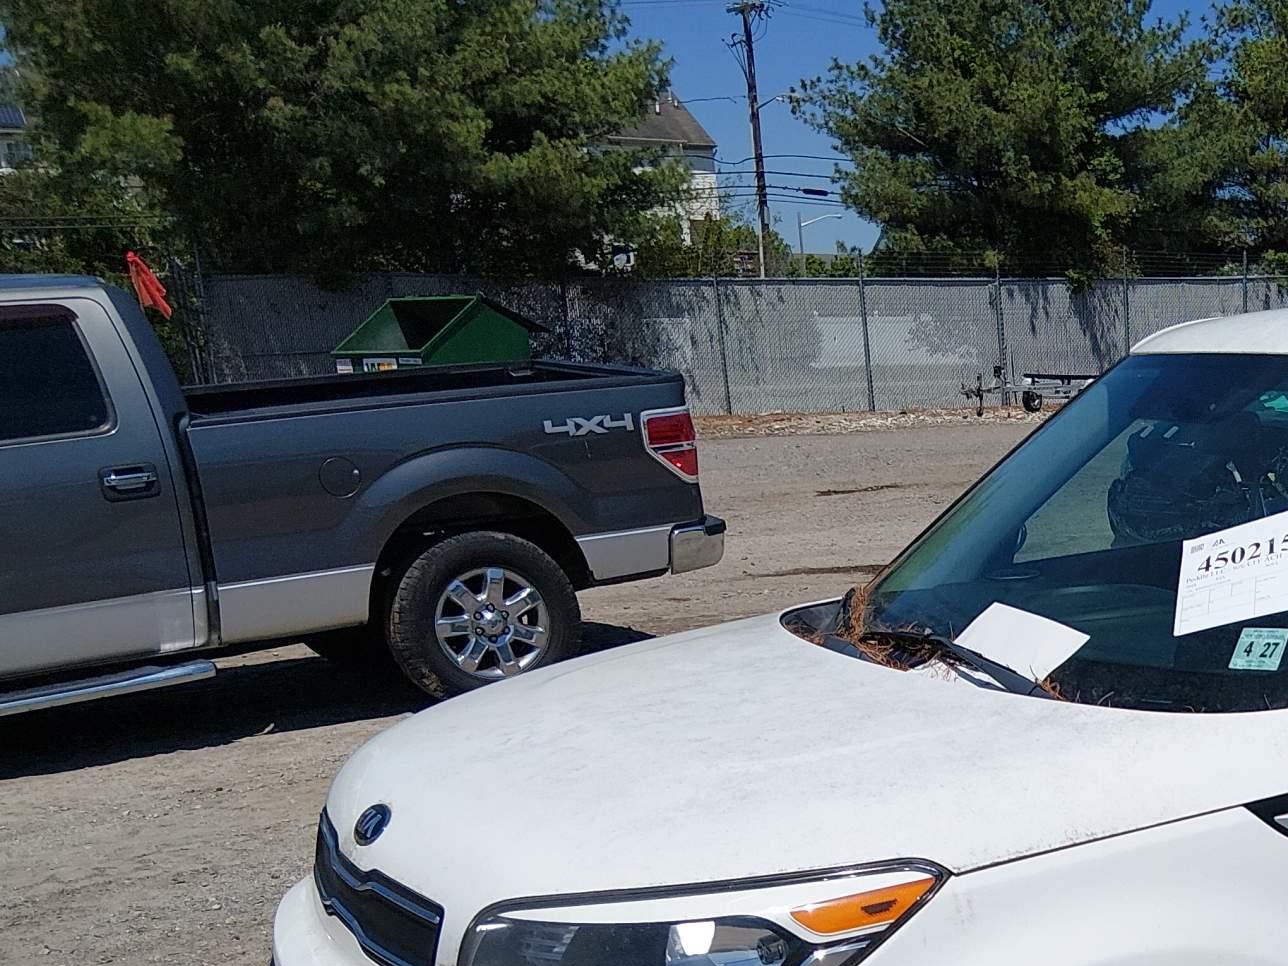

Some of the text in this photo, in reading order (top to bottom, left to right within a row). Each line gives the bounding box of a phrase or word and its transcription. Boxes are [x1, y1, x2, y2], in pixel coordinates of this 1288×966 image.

[543, 412, 635, 437] 4X4
[1243, 641, 1280, 658] 4 27
